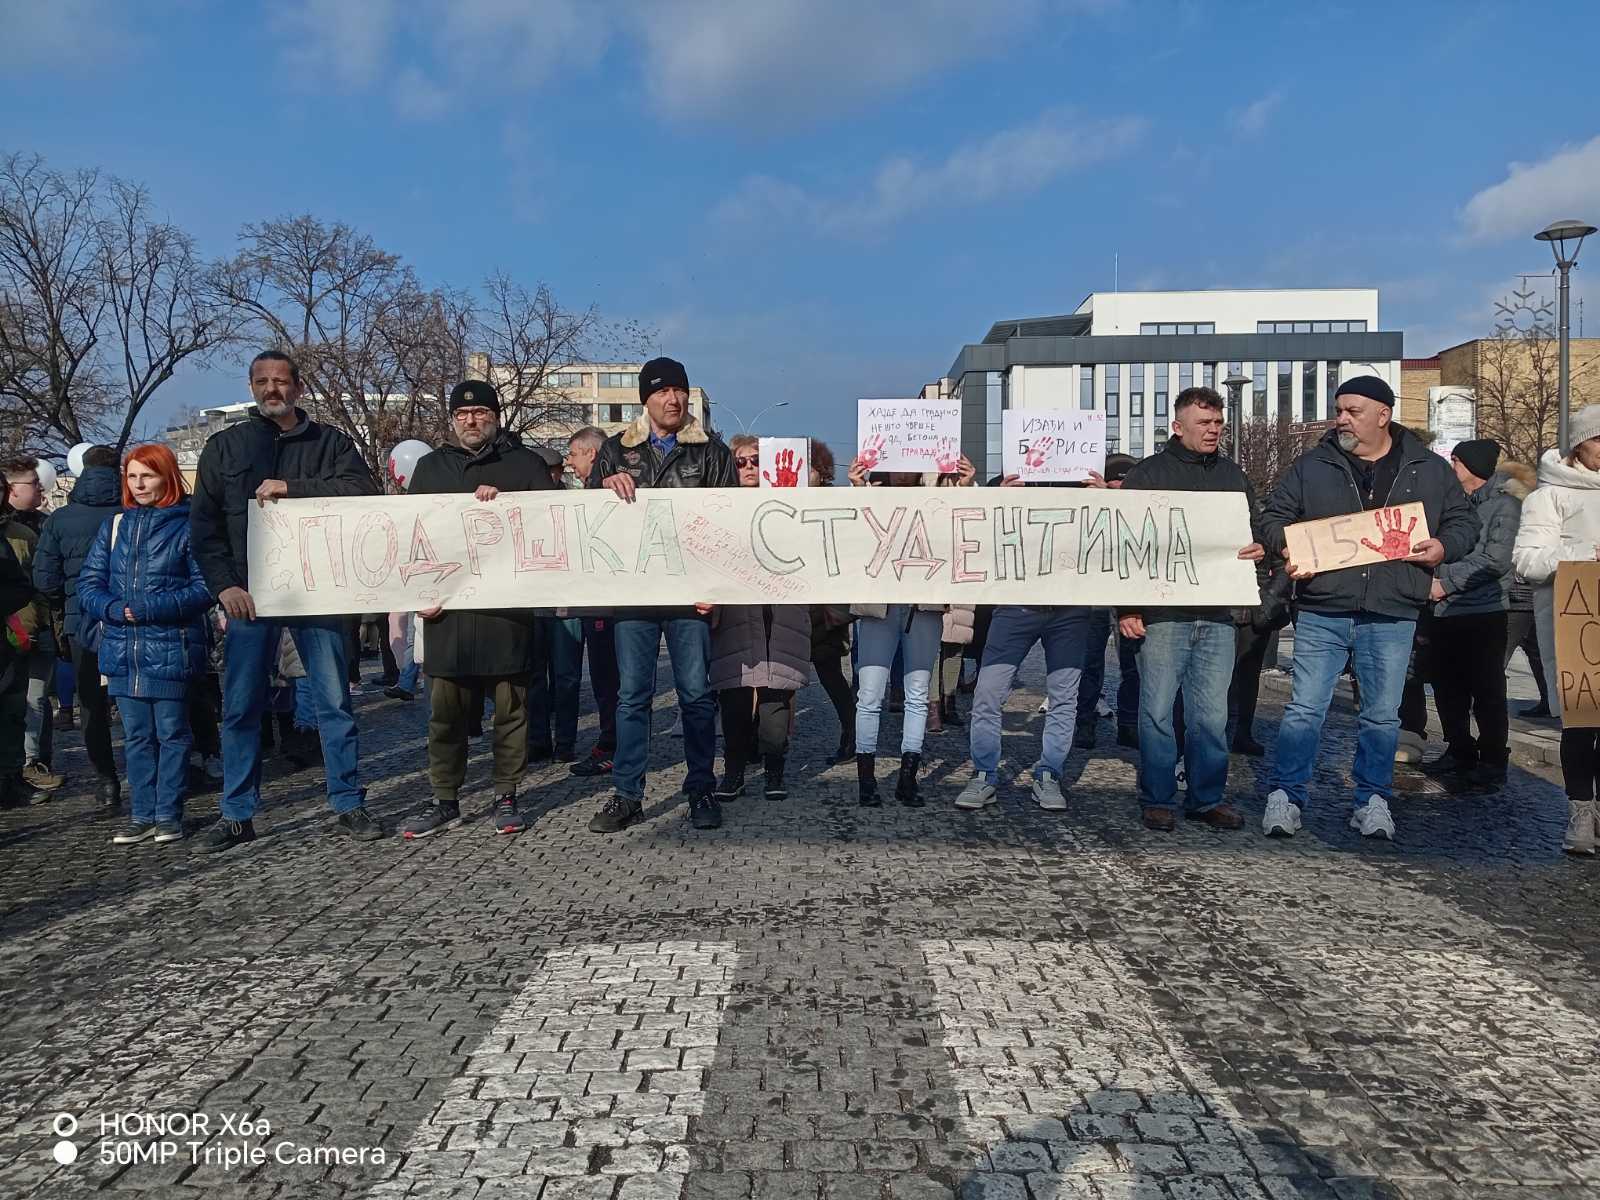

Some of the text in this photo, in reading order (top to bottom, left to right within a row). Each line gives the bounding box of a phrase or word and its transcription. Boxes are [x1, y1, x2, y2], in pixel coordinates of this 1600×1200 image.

[1022, 417, 1082, 433] ИЗАЂИ И
[1080, 441, 1099, 454] СЕ
[298, 498, 1199, 592] ПОДРШКА СТУДЕНТИМА
[1304, 518, 1359, 568] 15
[1560, 578, 1600, 617] Д
